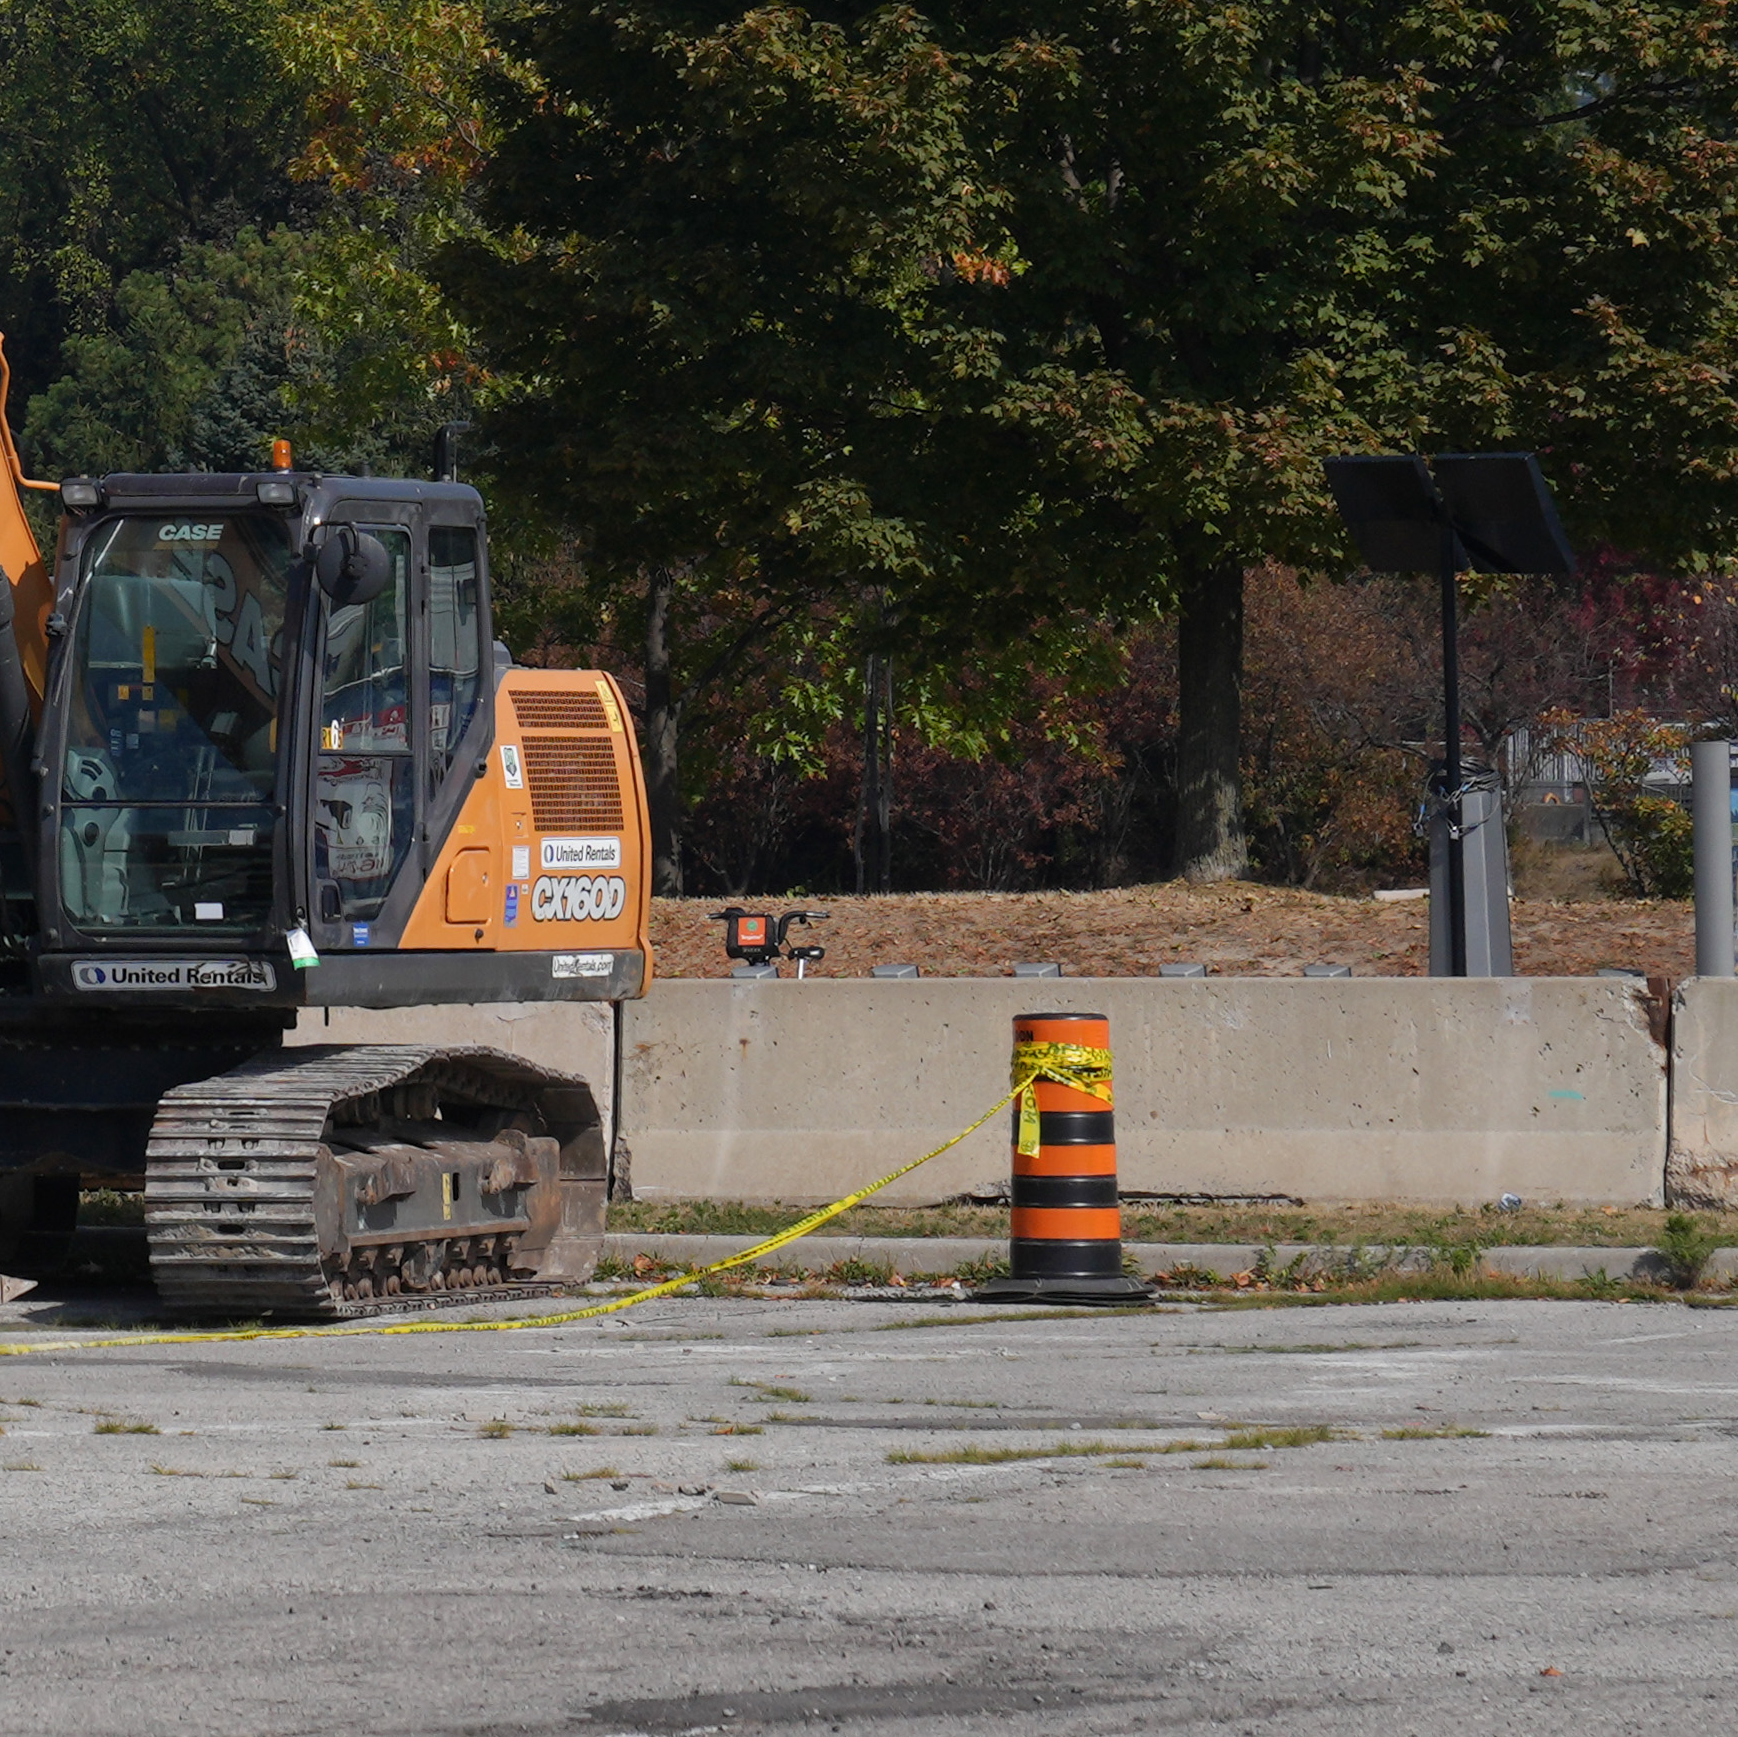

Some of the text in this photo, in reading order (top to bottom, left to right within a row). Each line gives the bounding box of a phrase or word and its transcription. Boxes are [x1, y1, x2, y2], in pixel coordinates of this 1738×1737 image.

[159, 524, 224, 540] CASE
[556, 845, 616, 862] United Rentals
[531, 874, 626, 922] CX160D
[112, 967, 268, 985] United Rentals
